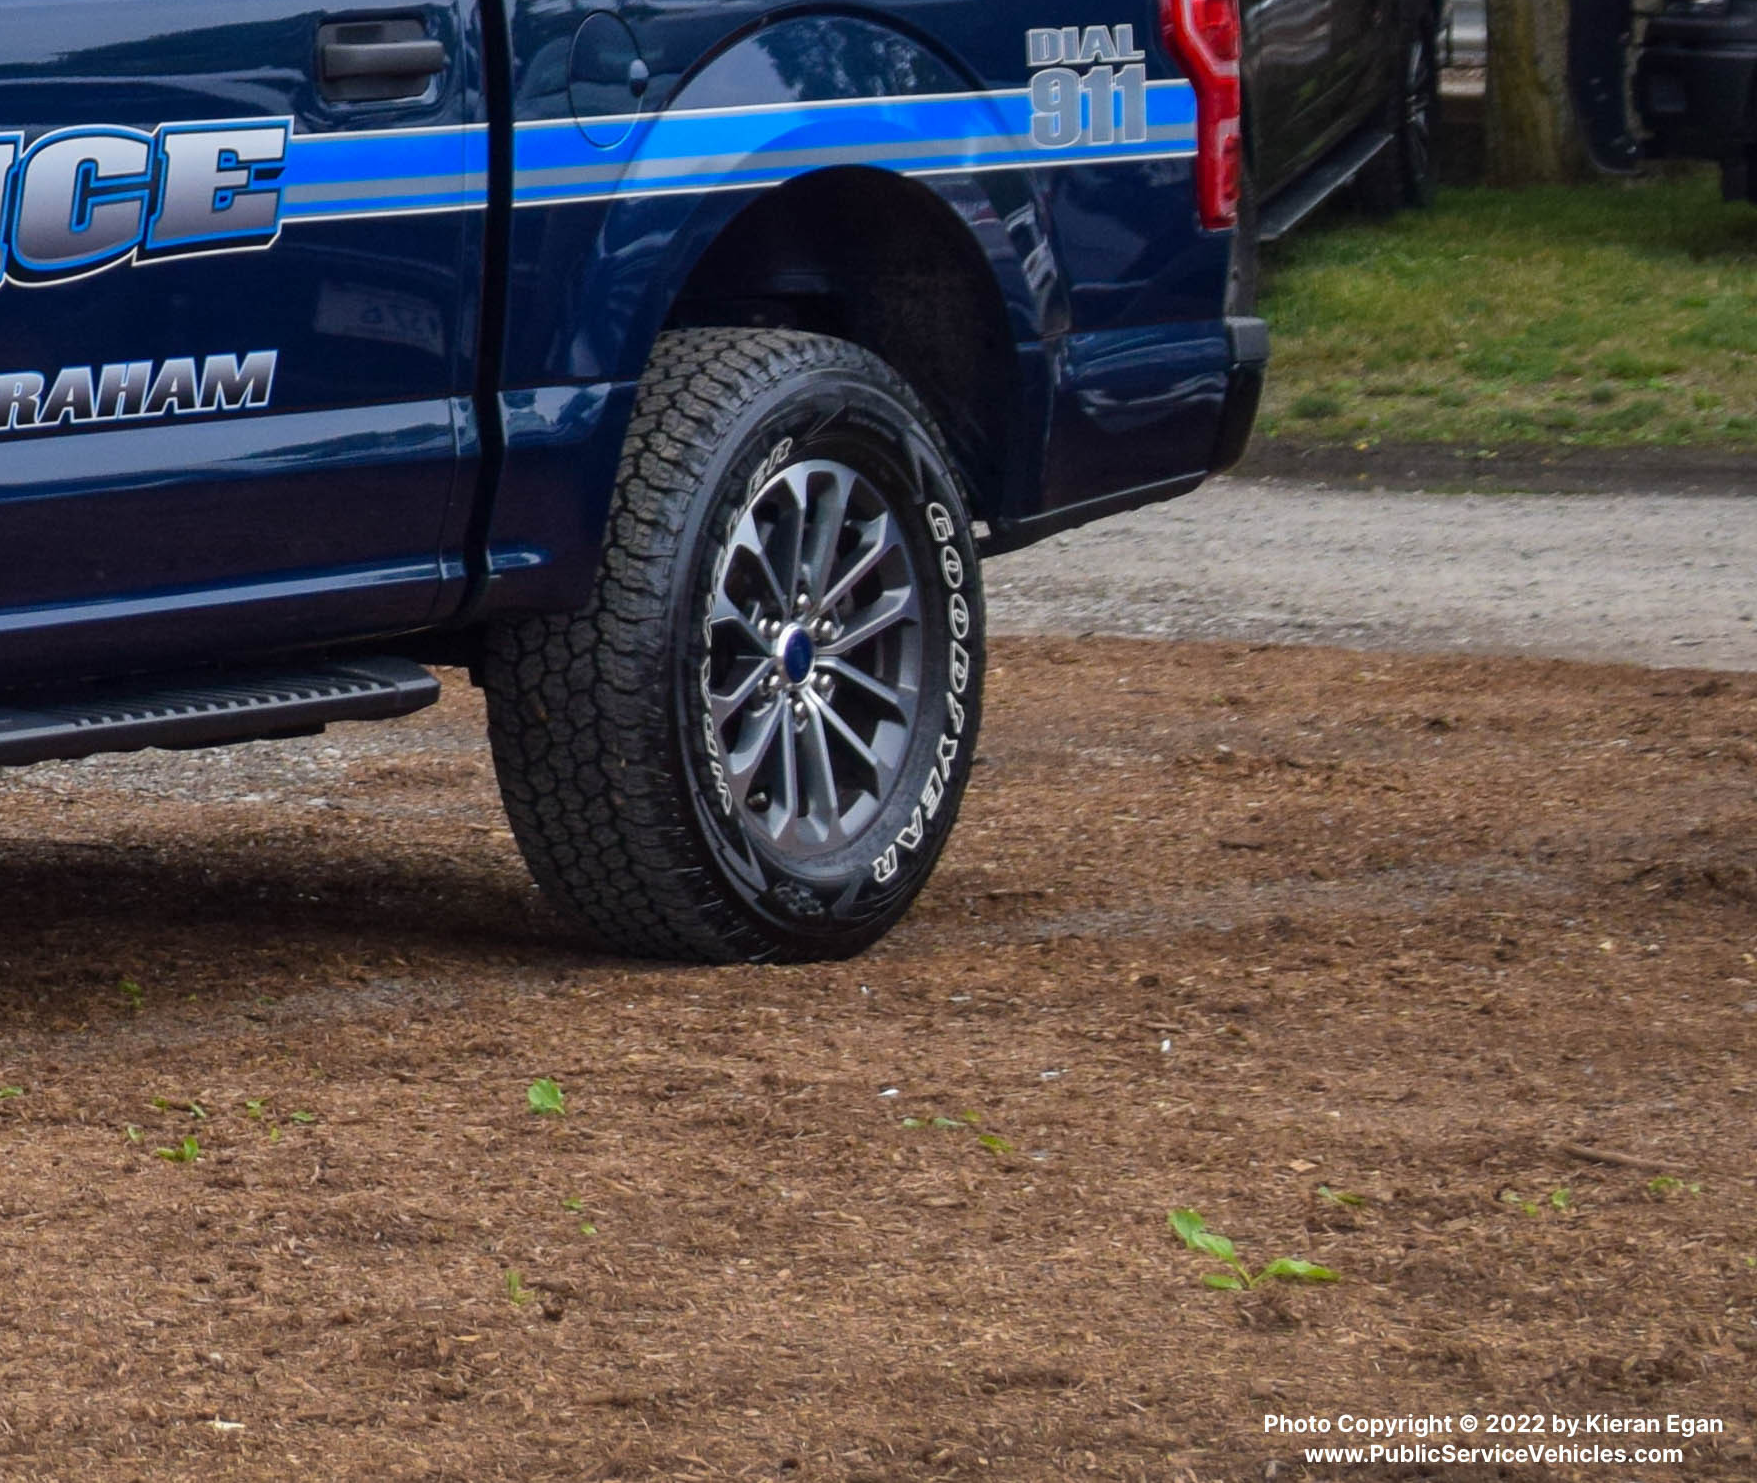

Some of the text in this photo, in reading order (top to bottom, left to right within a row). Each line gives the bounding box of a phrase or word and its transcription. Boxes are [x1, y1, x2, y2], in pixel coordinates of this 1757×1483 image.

[1026, 23, 1146, 67] DIAL
[1030, 63, 1147, 149] 911
[871, 502, 971, 884] GOODYEAR
